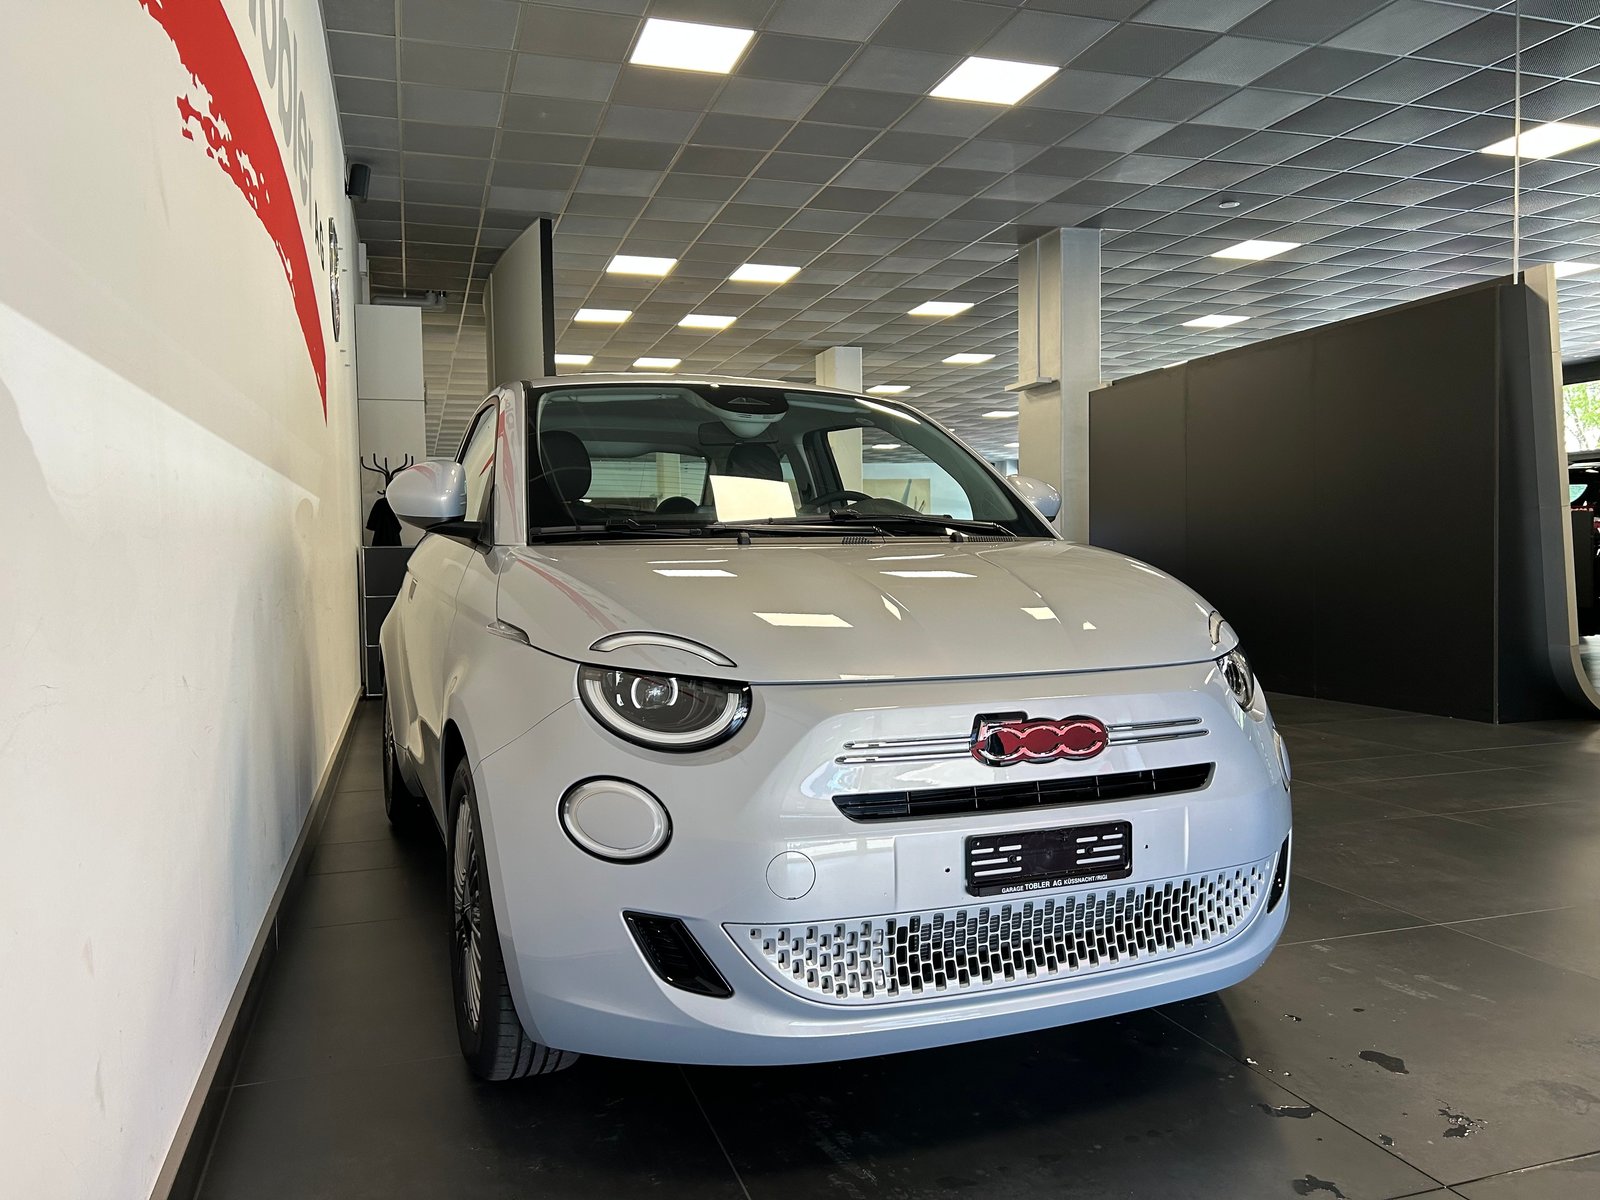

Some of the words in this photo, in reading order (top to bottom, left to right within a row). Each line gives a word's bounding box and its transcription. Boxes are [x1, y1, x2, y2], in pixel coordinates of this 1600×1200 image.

[248, 0, 313, 229] obler
[971, 711, 1108, 767] 500
[1024, 881, 1050, 890] TOBLER
[1063, 874, 1108, 885] KÜSSNACHT/RIGI
